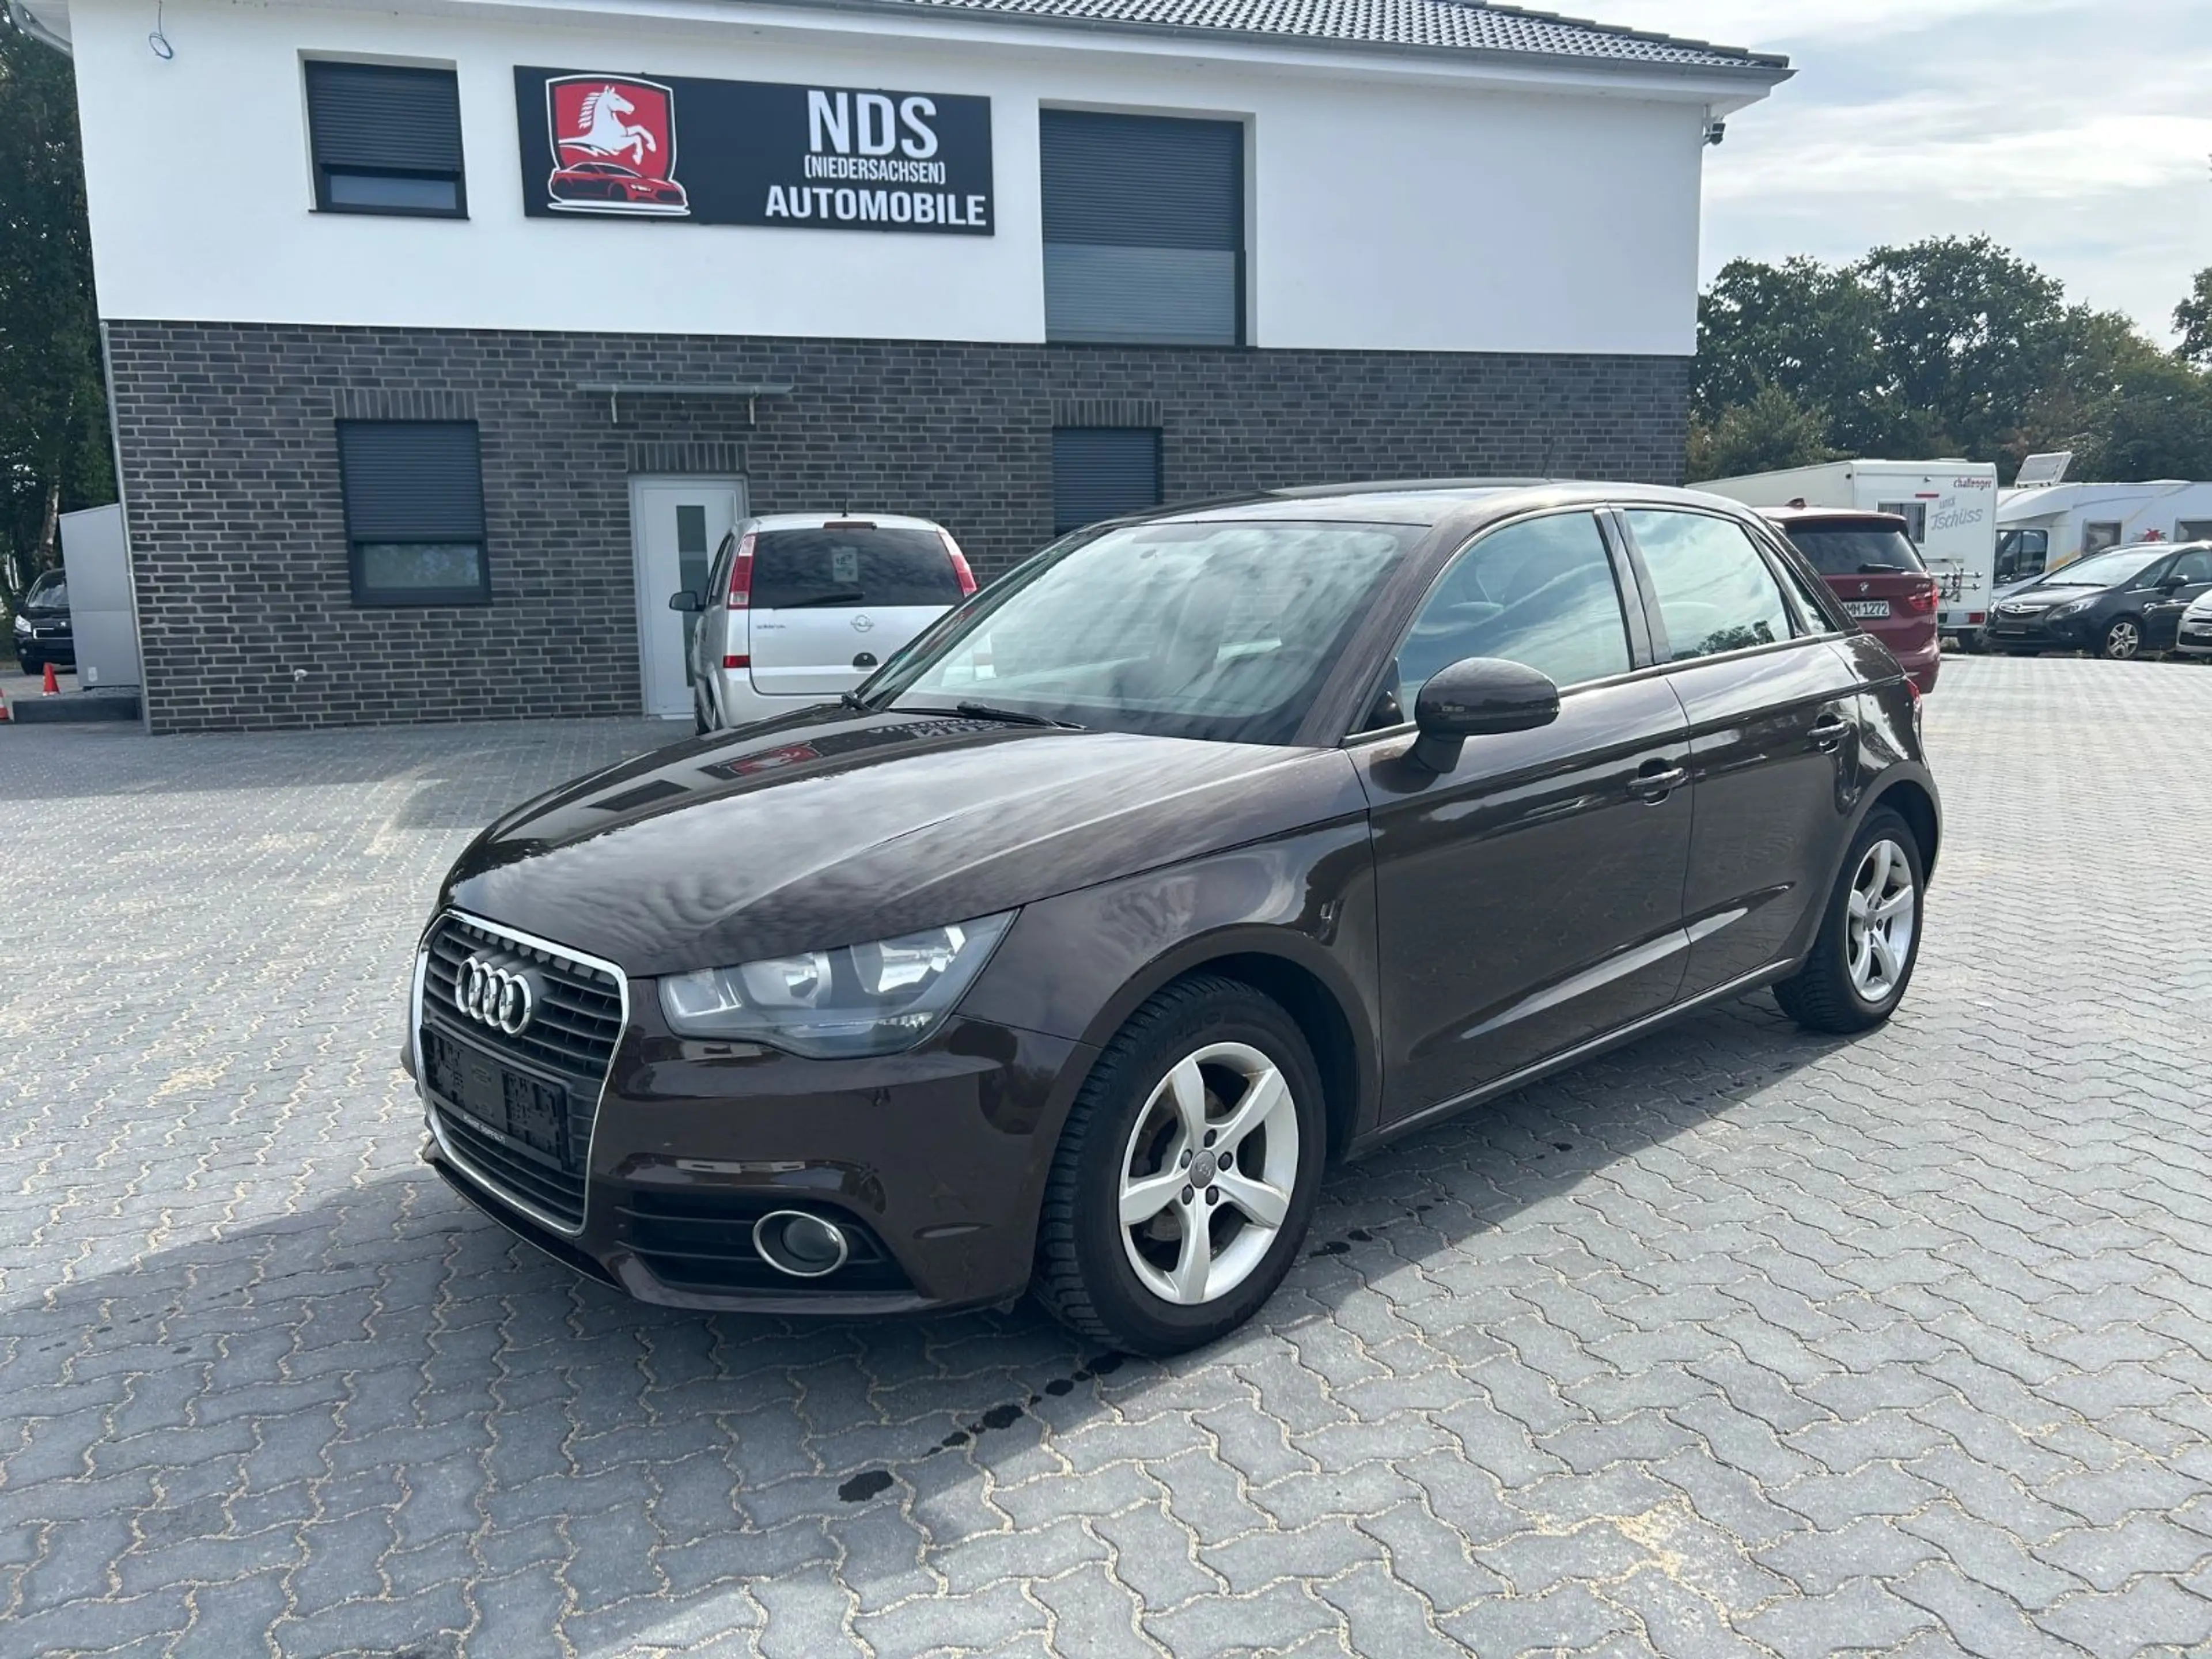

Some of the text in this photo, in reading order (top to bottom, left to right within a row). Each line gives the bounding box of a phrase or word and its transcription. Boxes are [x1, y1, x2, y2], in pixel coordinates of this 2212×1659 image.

[808, 90, 938, 158] NDS
[804, 154, 946, 185] (NIEDERSACHSEN)
[766, 185, 987, 225] AUTOMOBILE
[1862, 603, 1888, 615] 1272
